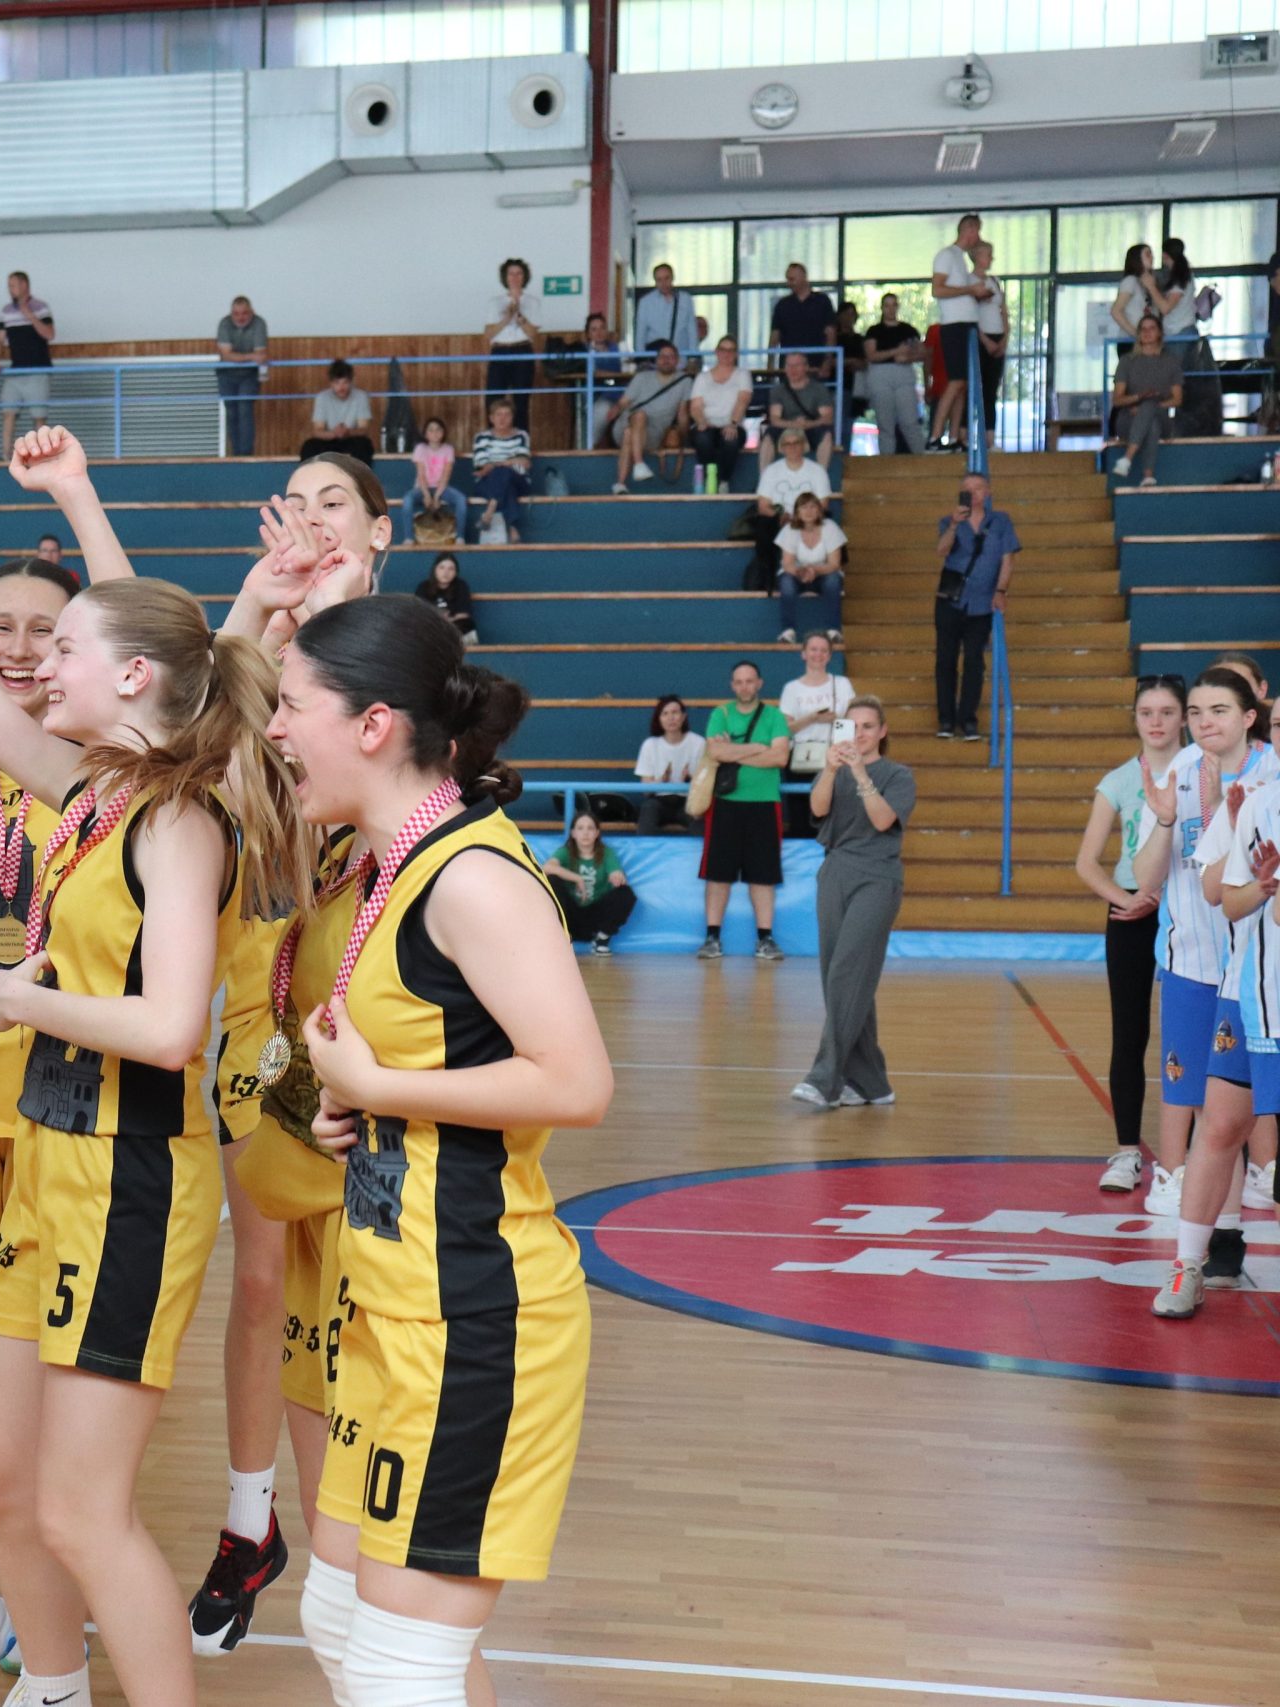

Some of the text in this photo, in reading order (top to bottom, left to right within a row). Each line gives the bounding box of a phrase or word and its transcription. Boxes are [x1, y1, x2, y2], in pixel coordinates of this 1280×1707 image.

[1181, 815, 1205, 858] F
[230, 1073, 265, 1098] 19
[47, 1263, 80, 1328] 5
